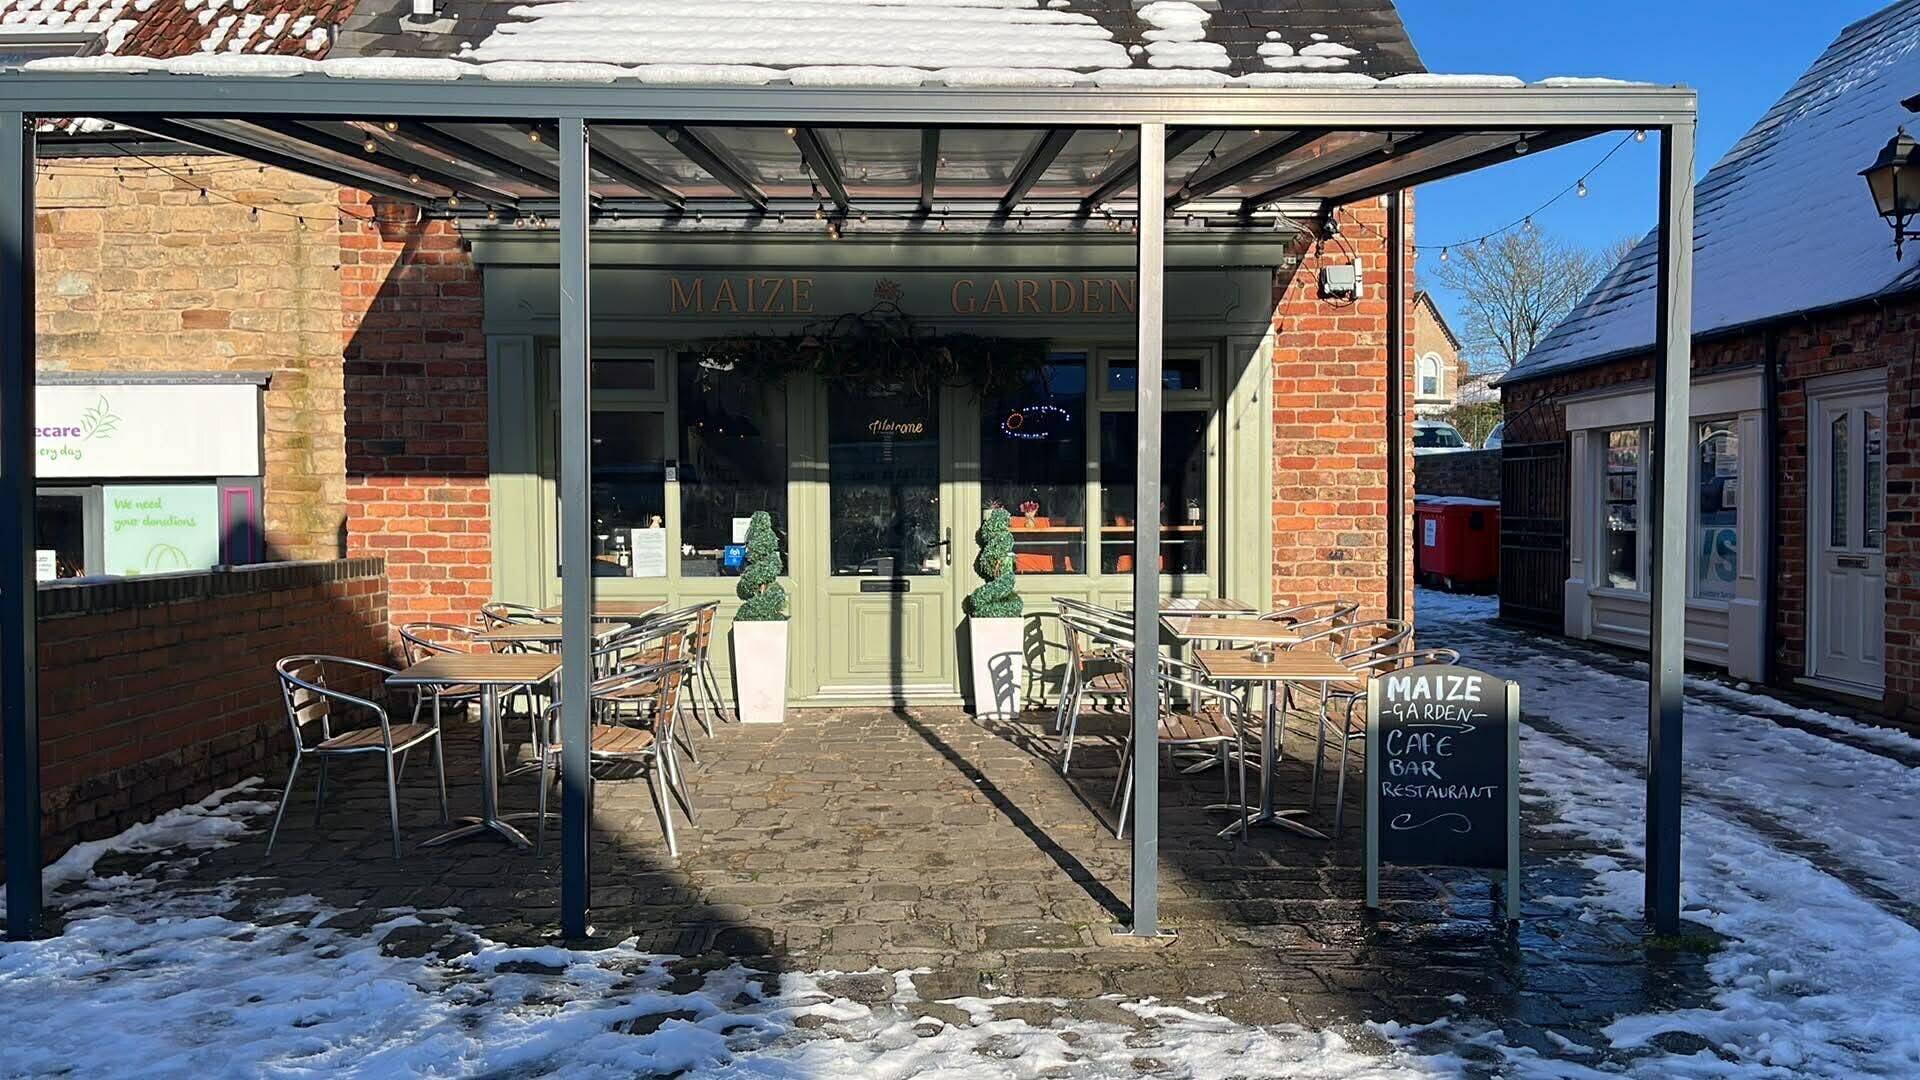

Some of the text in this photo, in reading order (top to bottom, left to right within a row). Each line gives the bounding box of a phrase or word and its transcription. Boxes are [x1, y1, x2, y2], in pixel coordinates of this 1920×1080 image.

[670, 277, 1136, 314] MAIZE GARDEN
[38, 444, 82, 460] ery day
[114, 497, 163, 510] We need
[114, 515, 196, 532] your donations
[1387, 675, 1482, 701] MAIZE
[1386, 729, 1452, 756] CAFE
[1388, 759, 1442, 780] BAR
[1382, 781, 1498, 799] RESTAURANT
